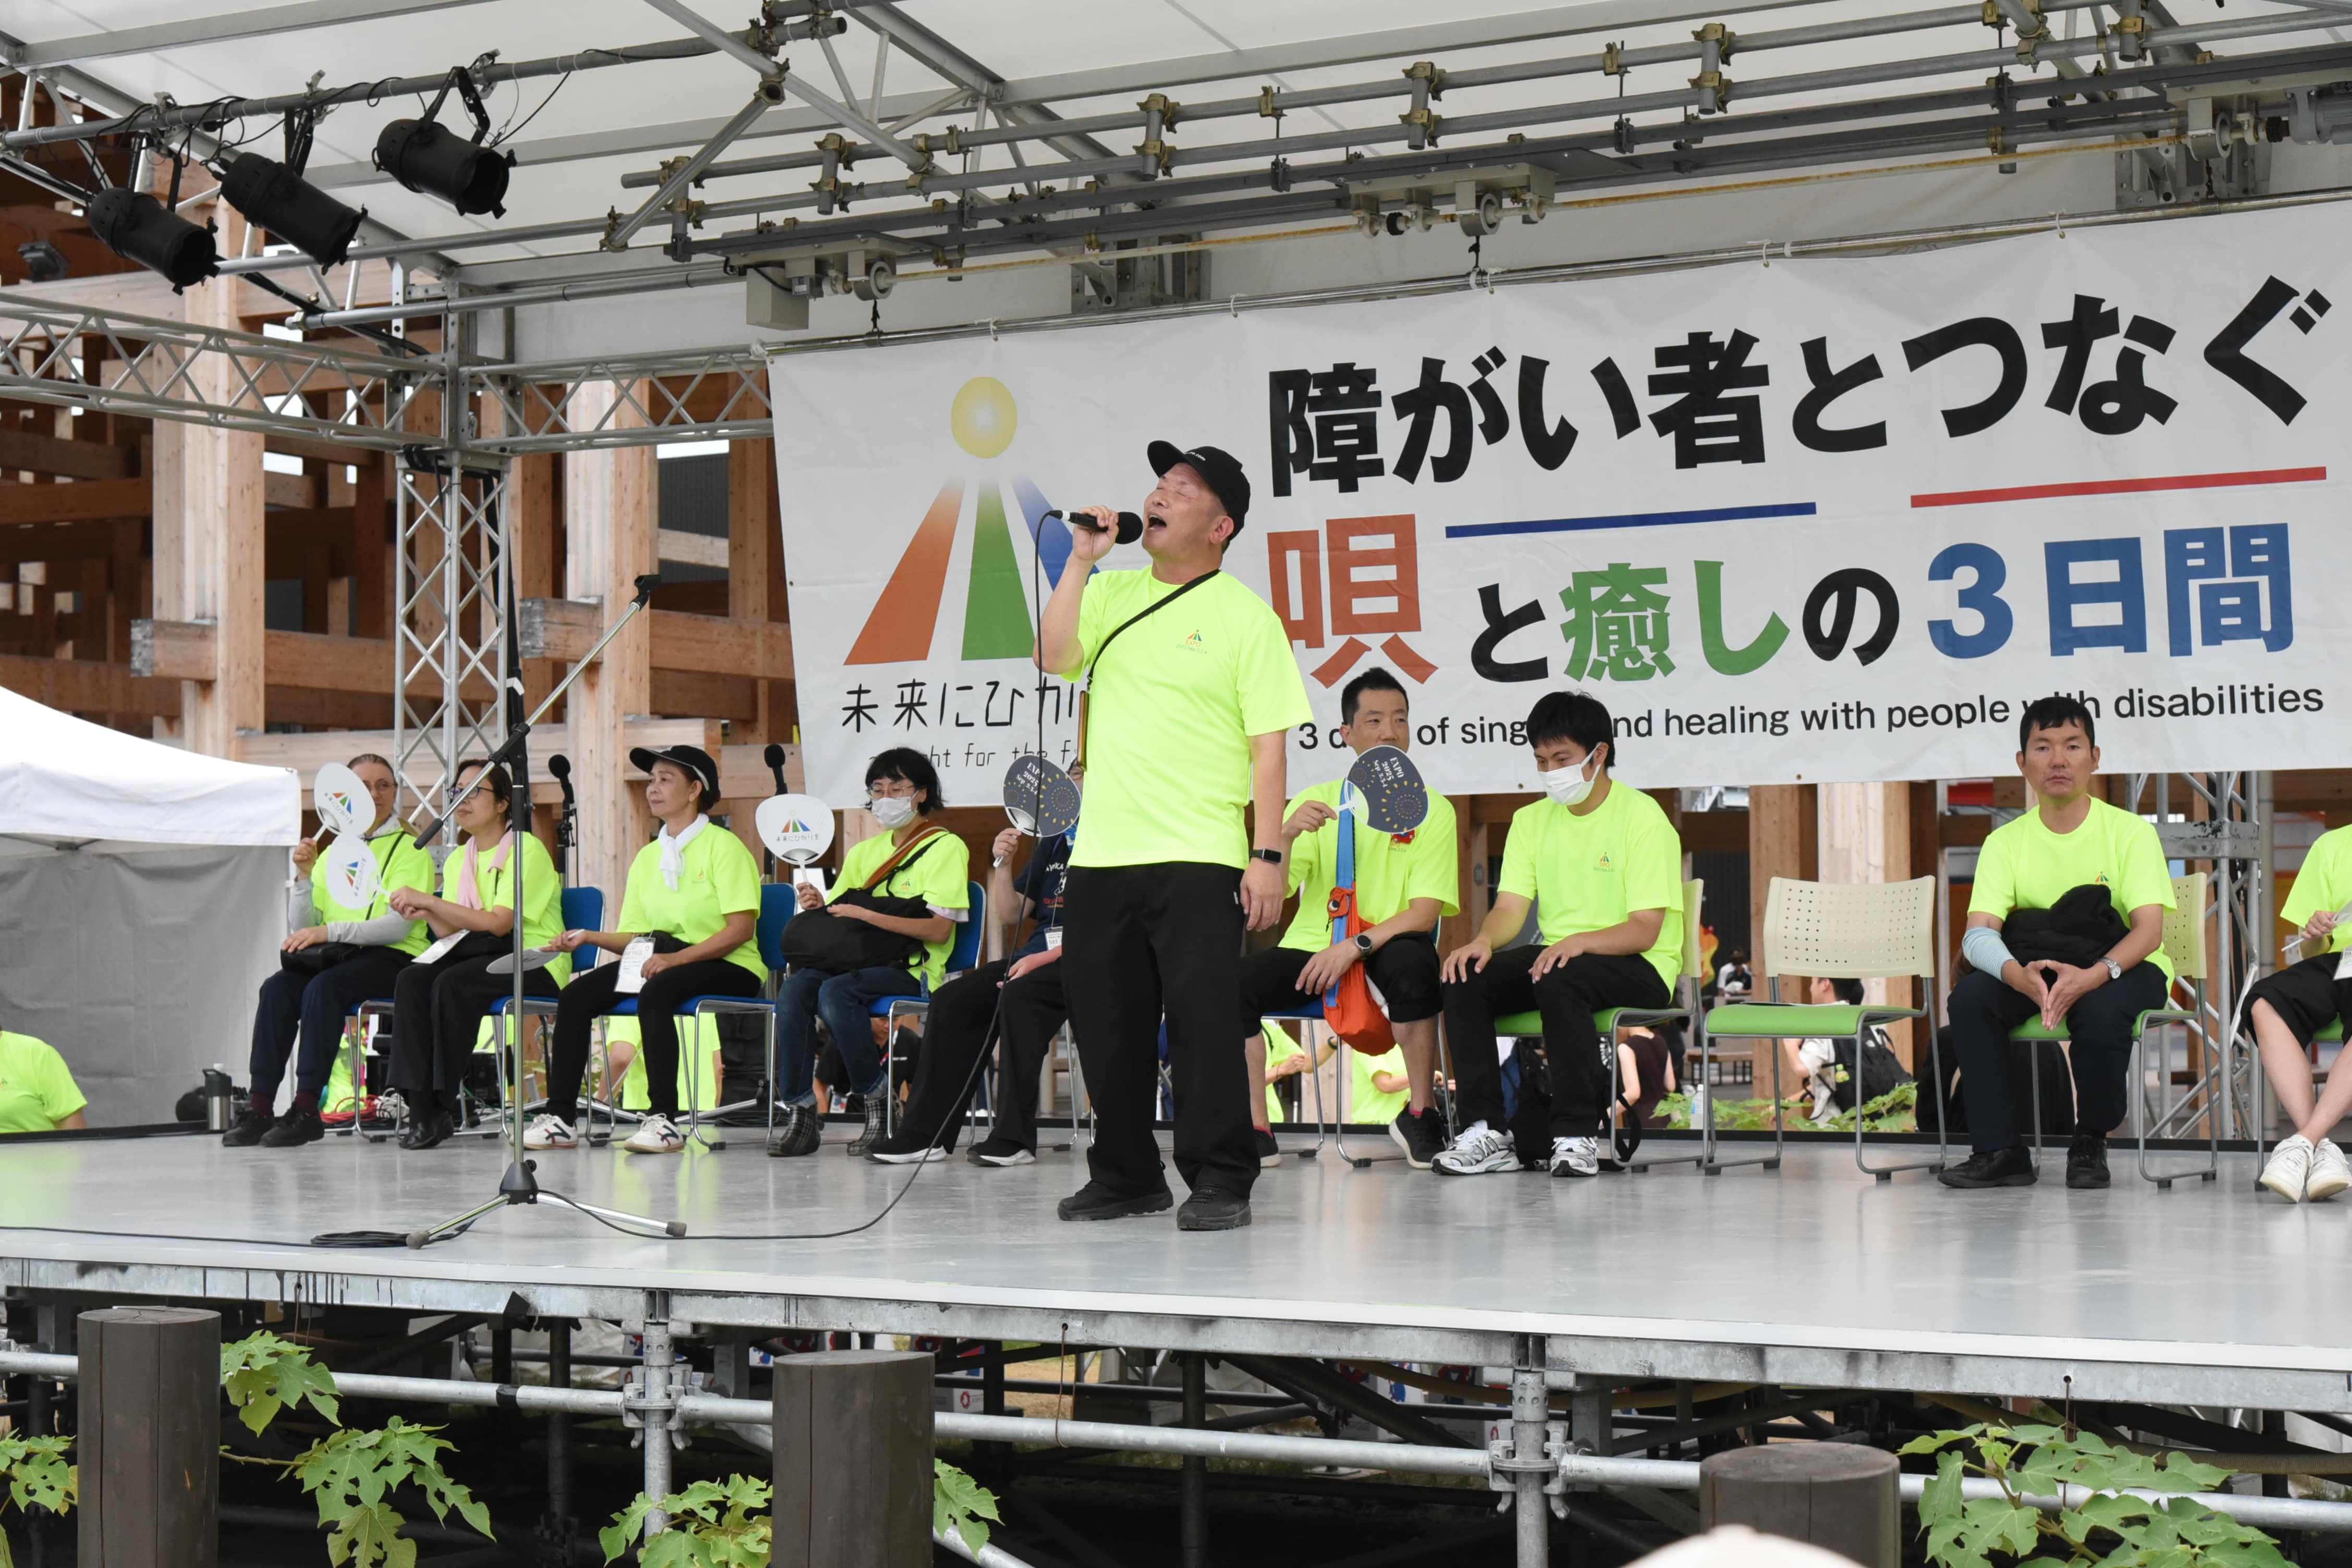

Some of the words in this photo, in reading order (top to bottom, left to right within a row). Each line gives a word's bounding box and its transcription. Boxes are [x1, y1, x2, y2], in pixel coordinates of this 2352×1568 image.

[1269, 275, 2332, 497] 障がい者とつなぐ
[1267, 514, 2294, 688] 唄と癒しの3日間
[842, 676, 1075, 733] 未来にひか
[1299, 722, 1318, 750] 3
[1417, 717, 1450, 745] of
[1461, 716, 1527, 746] sing
[1613, 709, 1652, 738] nd
[1665, 705, 1789, 738] healing
[1800, 701, 1876, 731] with
[1888, 695, 2010, 733] people
[2114, 683, 2324, 718] disabilities
[964, 743, 996, 767] for
[1381, 761, 1394, 781] 2025
[1390, 756, 1404, 778] EXPO
